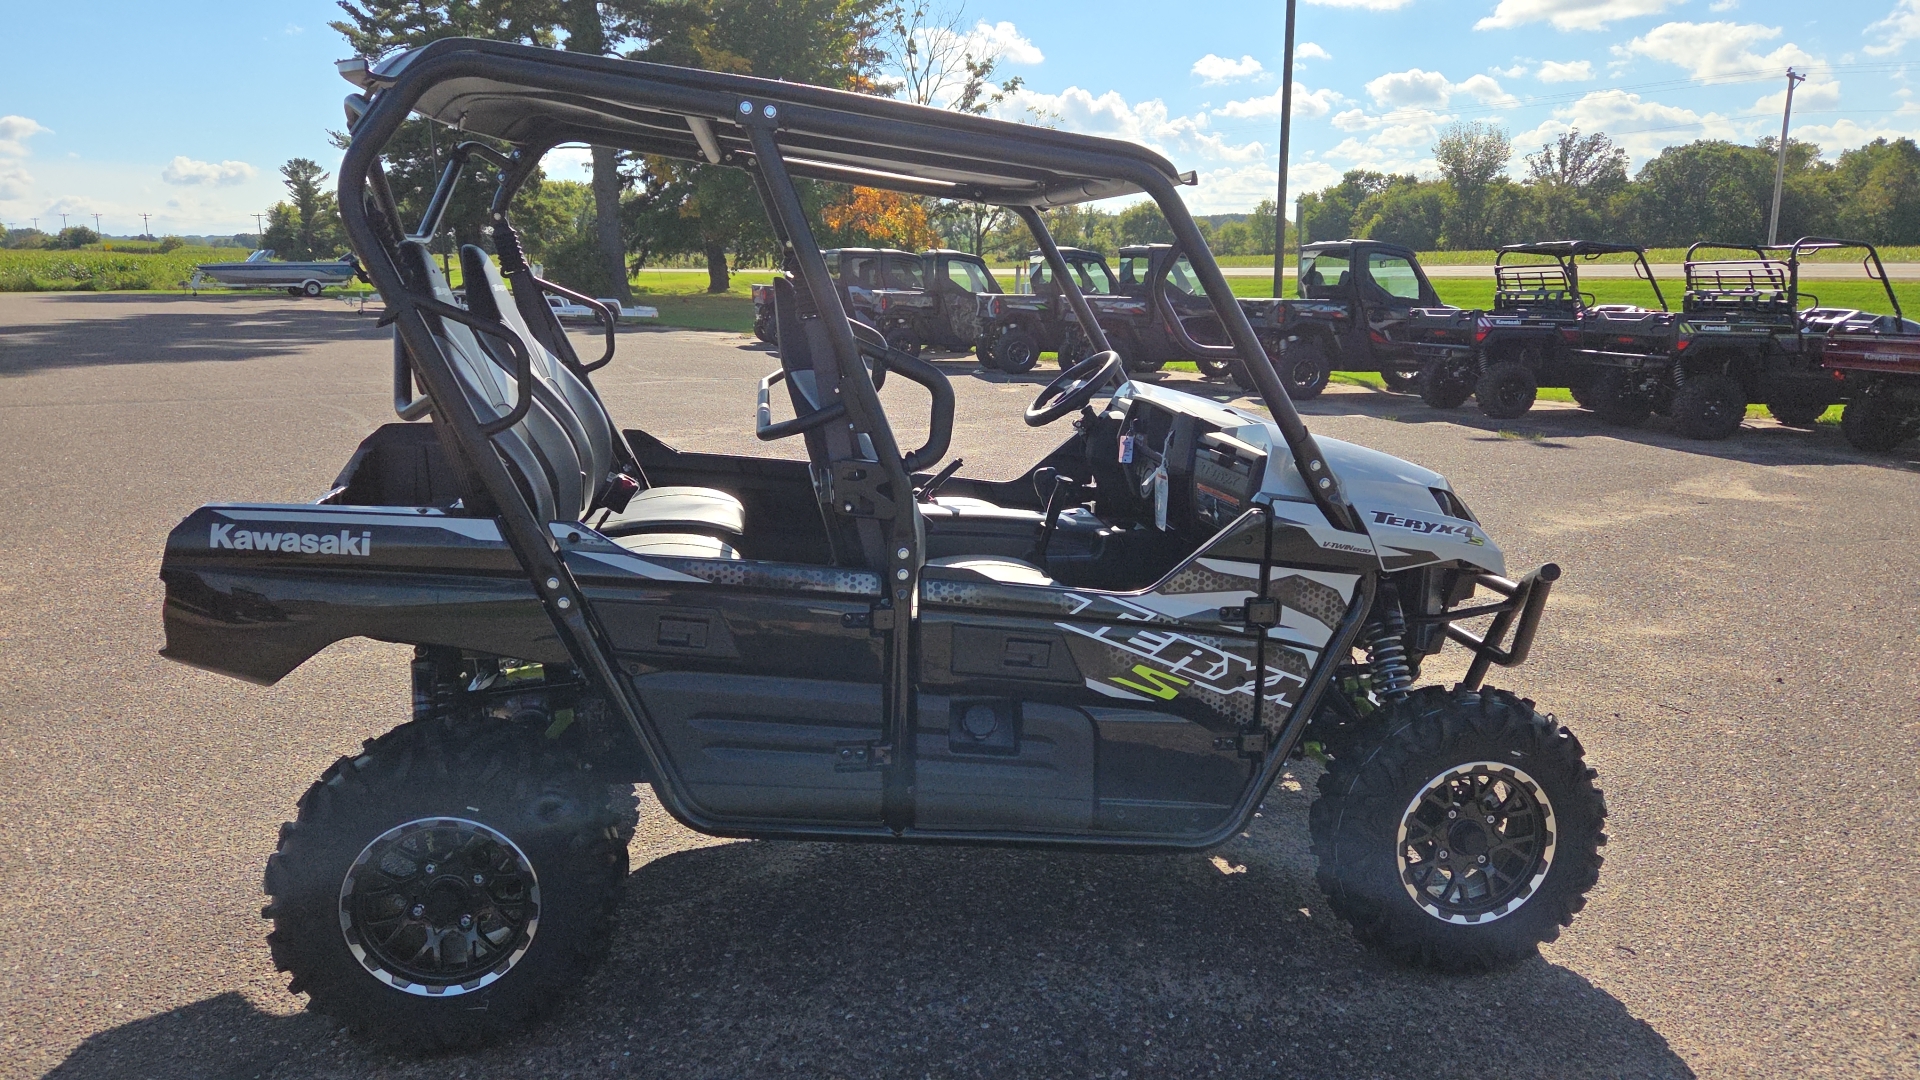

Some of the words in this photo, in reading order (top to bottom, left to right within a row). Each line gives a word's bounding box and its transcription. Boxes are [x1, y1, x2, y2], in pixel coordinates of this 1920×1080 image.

[1863, 353, 1900, 362] Kawasaki
[209, 522, 371, 557] Kawasaki
[1108, 664, 1190, 701] S
